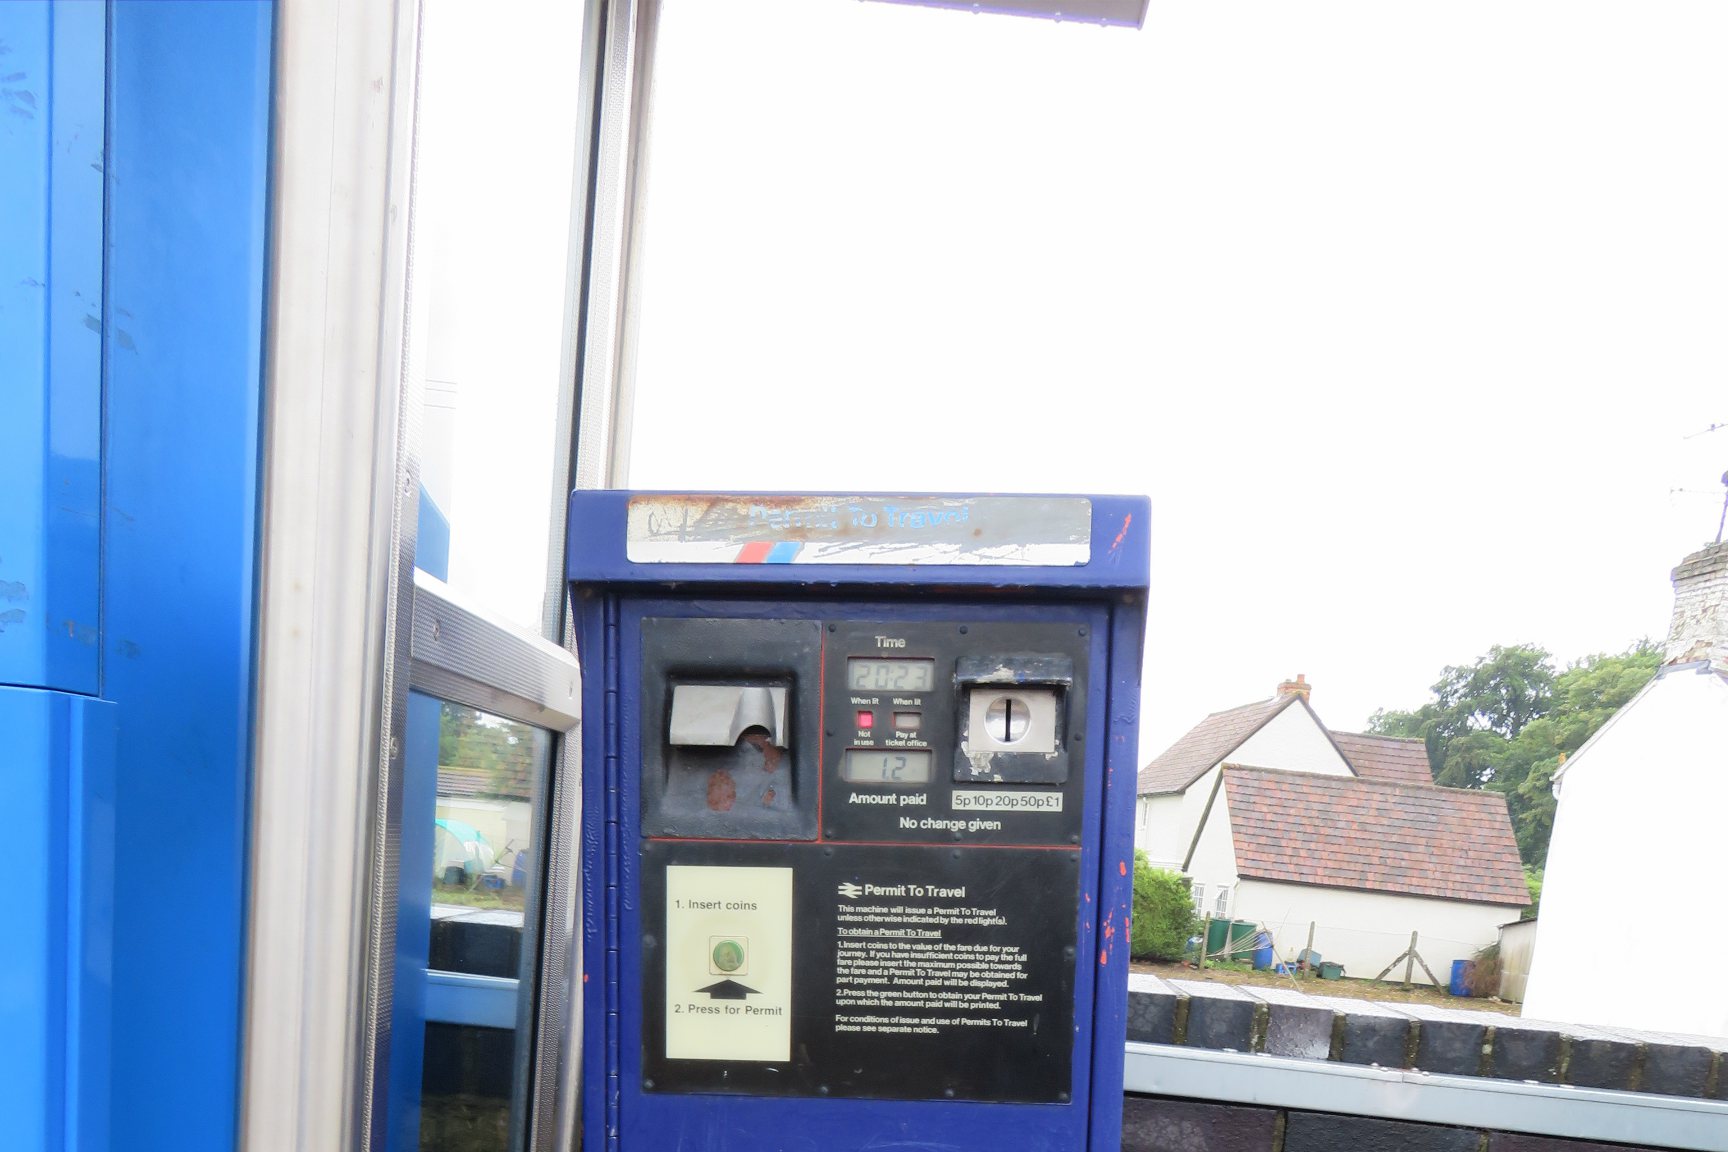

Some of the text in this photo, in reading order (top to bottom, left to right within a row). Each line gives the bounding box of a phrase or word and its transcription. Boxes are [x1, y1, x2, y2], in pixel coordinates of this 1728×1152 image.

[848, 506, 878, 528] To
[875, 636, 905, 648] Time
[850, 697, 870, 705] When
[896, 731, 909, 739] Pay
[886, 739, 905, 747] ticket
[849, 793, 927, 806] Amount paid
[955, 796, 1059, 809] 5p 10p 20p 50p £1
[900, 817, 1001, 832] No change given
[865, 884, 965, 897] Permit To Travel
[676, 900, 757, 910] 1. Insert coins
[934, 907, 959, 915] Permit
[837, 950, 867, 958] journey.
[970, 980, 1009, 988] displayed.
[675, 1005, 782, 1016] 2. Press for Permit
